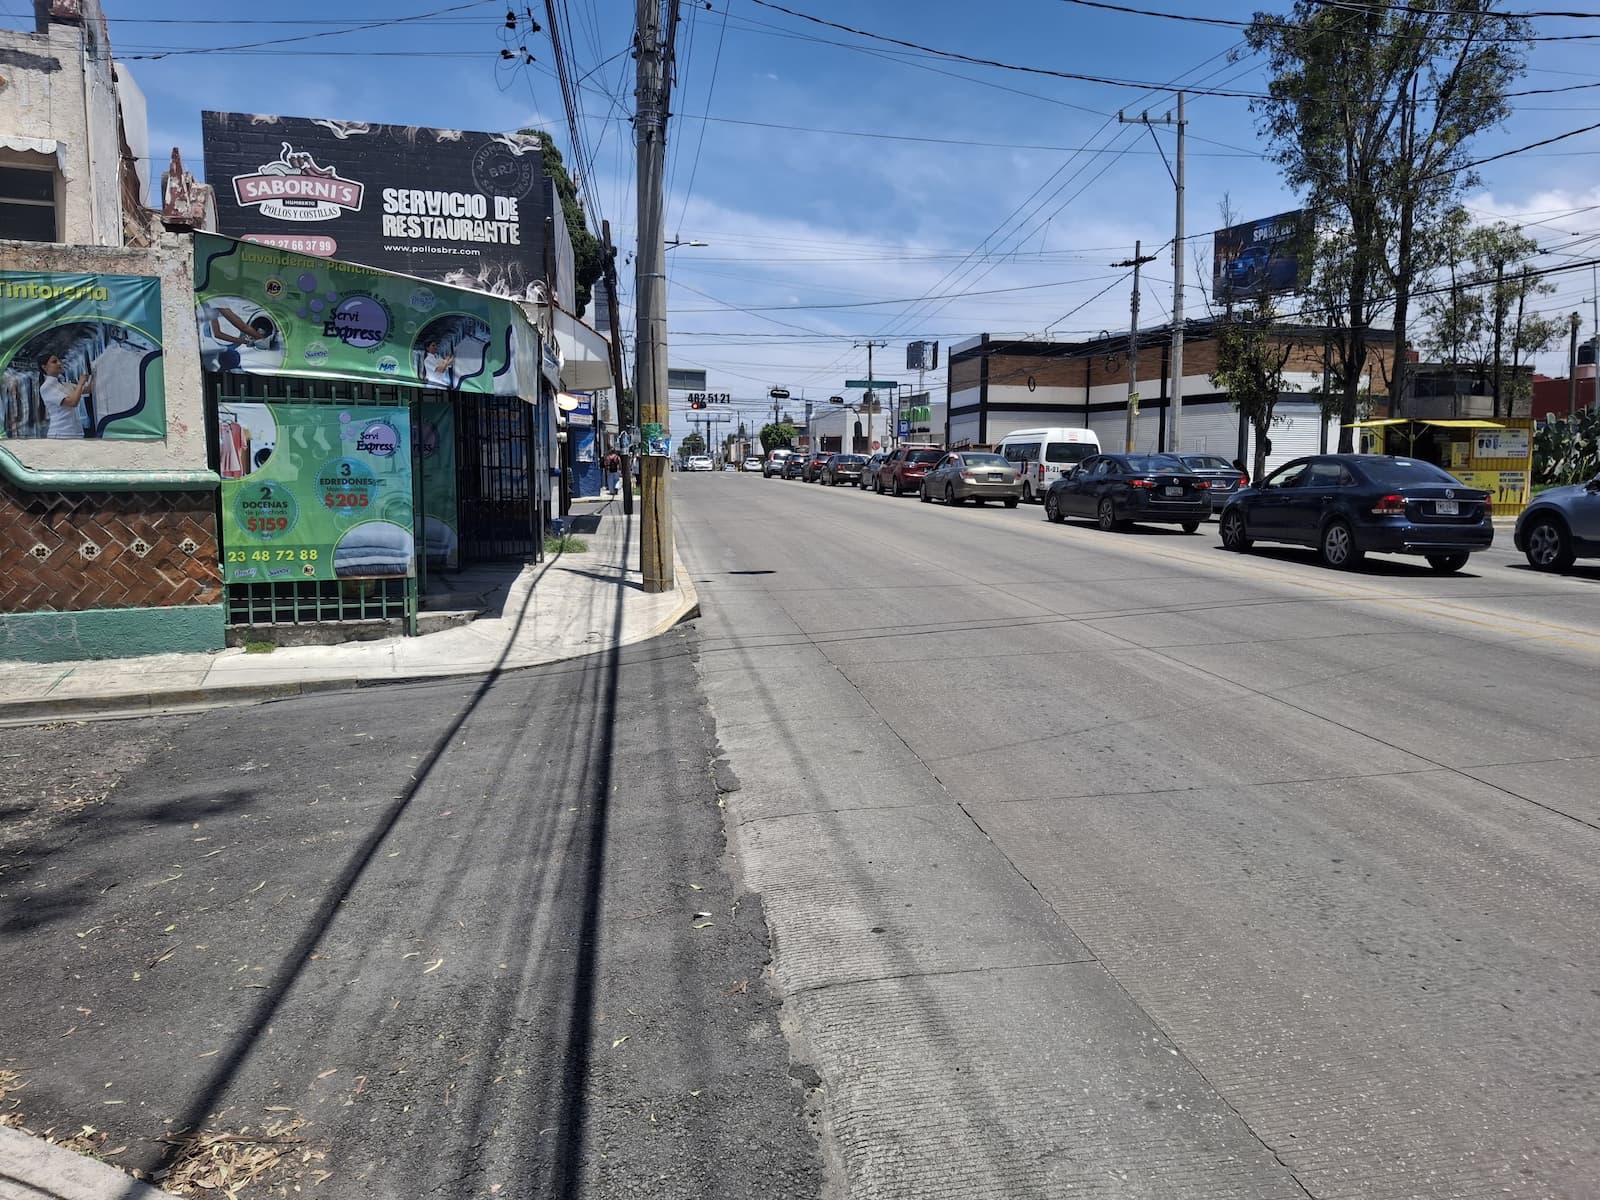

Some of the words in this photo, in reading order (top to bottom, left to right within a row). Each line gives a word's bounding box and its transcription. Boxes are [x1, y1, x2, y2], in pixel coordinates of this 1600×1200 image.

[263, 204, 291, 219] POLLOS
[291, 211, 297, 219] Y
[300, 206, 338, 219] COSTILLAS
[382, 188, 487, 219] SERVICIO
[494, 195, 519, 222] DE
[382, 214, 521, 245] RESTAURANTE
[291, 240, 304, 251] 66
[306, 240, 317, 251] 37
[319, 240, 331, 251] 99
[383, 244, 481, 256] www.pollosbrz.com
[329, 307, 360, 322] Servi
[322, 321, 382, 344] Express
[720, 393, 730, 404] 21
[360, 431, 379, 440] Servi
[356, 440, 394, 455] Express
[340, 463, 352, 477] 3
[320, 478, 374, 486] EDREDONES
[260, 486, 272, 500] 2
[324, 491, 369, 508] $205
[242, 501, 288, 509] DOCENAS
[247, 516, 288, 532] $159
[227, 551, 246, 562] 23
[252, 550, 270, 561] 48
[275, 550, 295, 561] 72
[300, 549, 318, 561] 88
